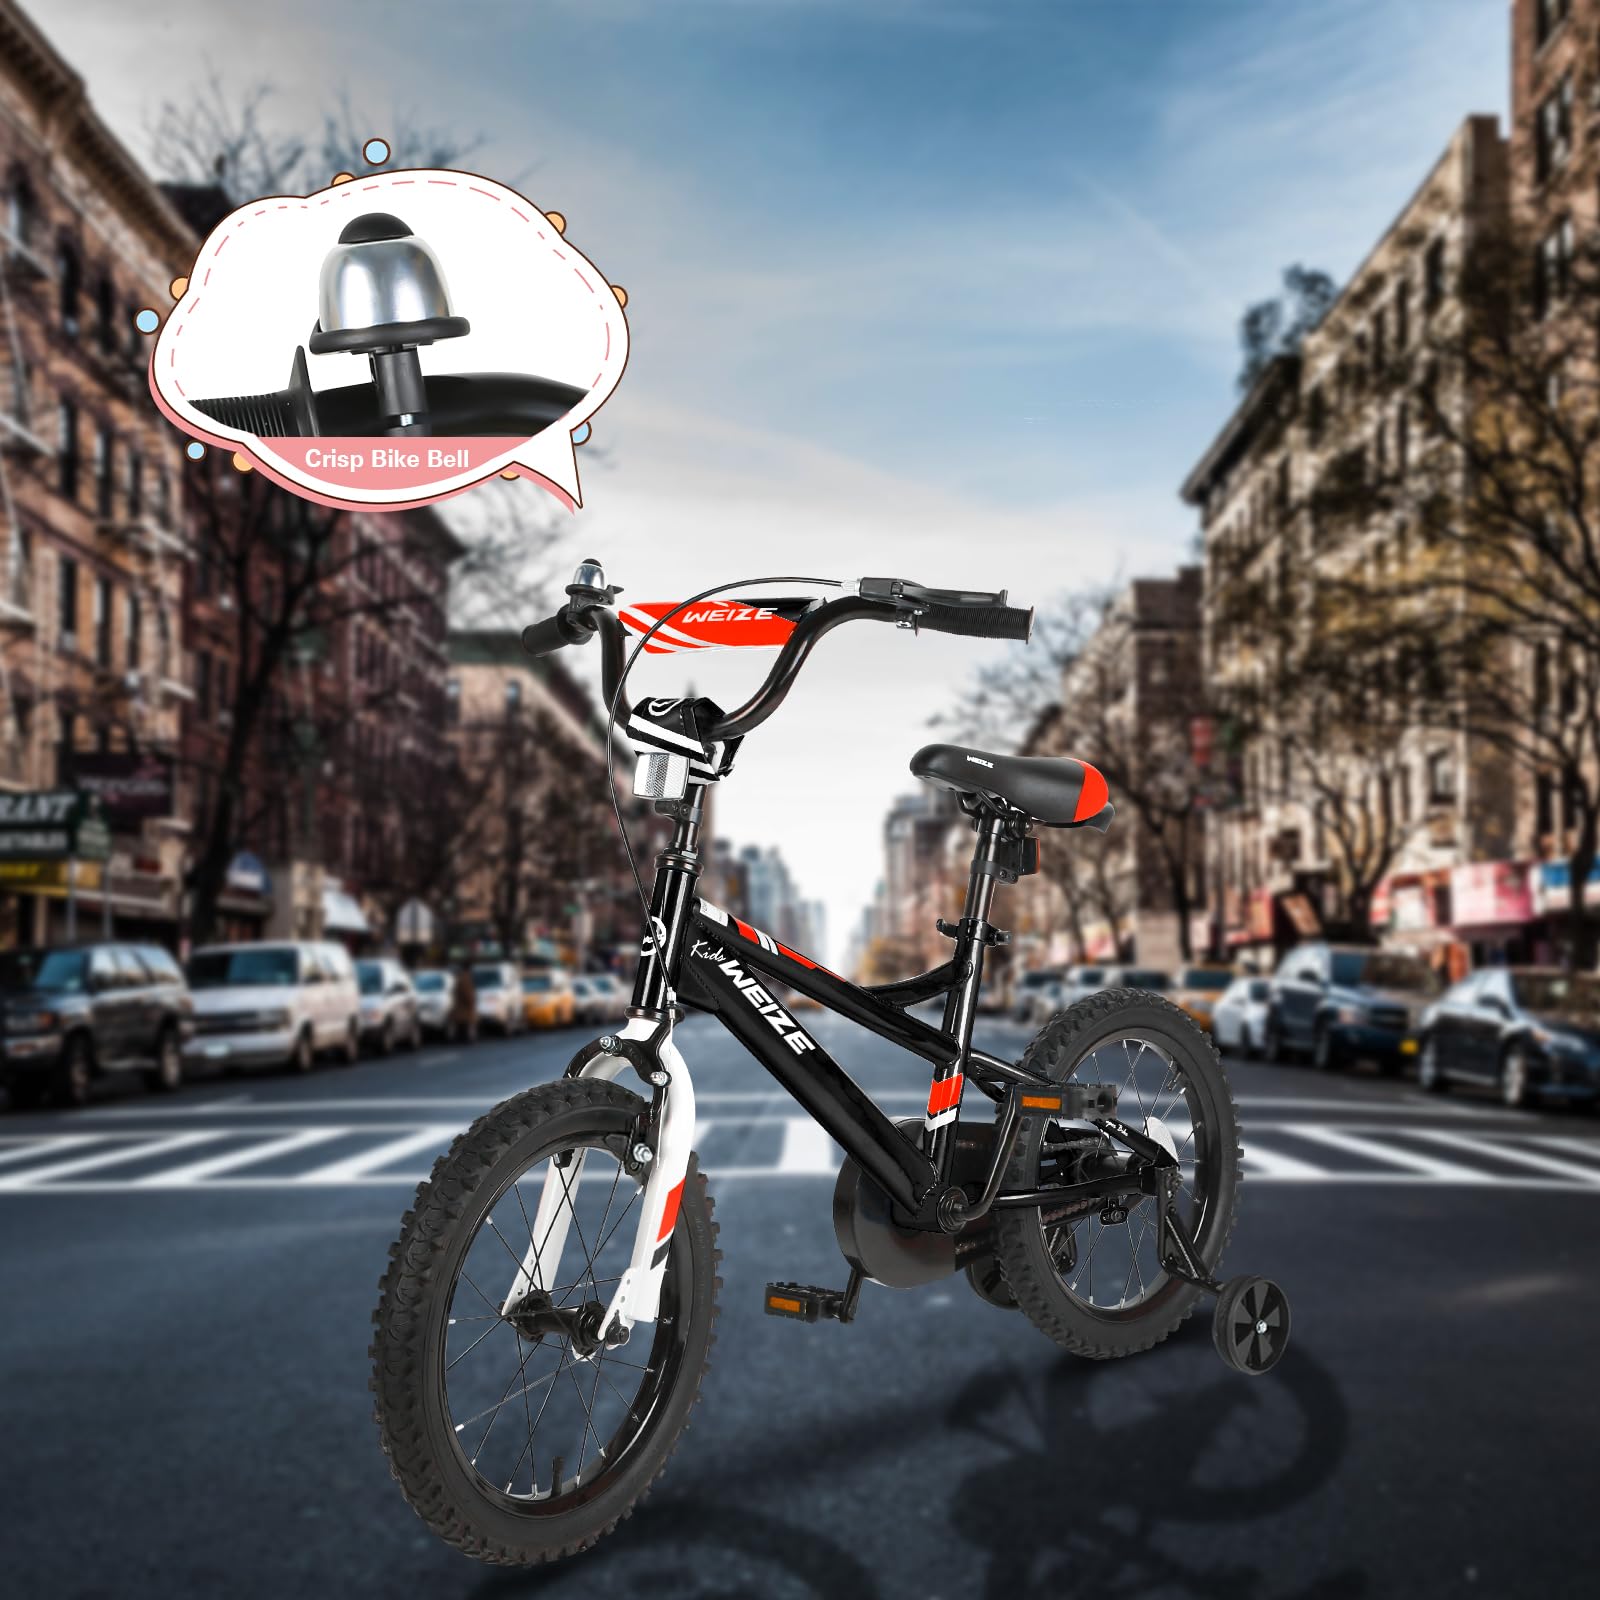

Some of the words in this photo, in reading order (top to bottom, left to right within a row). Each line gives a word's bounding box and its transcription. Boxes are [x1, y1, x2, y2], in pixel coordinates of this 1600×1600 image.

[681, 607, 779, 624] WEIZE
[690, 939, 727, 963] Kids
[718, 958, 816, 1056] WEIZE
